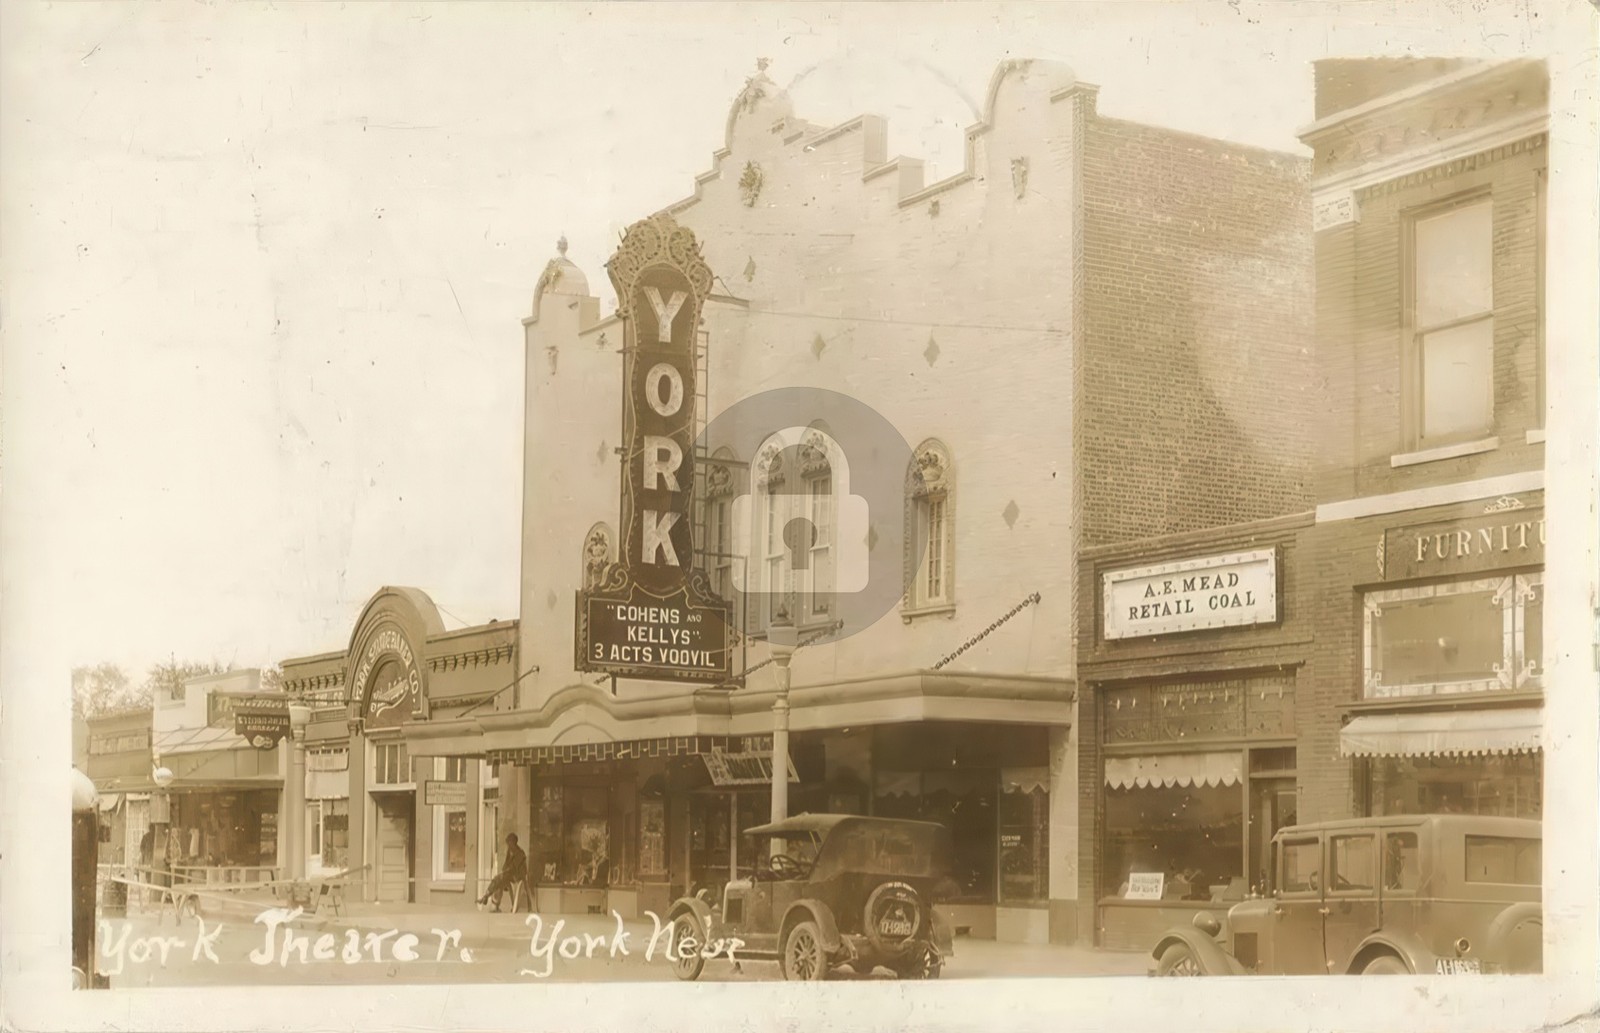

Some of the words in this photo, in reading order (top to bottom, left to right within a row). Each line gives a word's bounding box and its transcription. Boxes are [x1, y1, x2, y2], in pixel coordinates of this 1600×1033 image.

[641, 286, 689, 567] YORK
[1144, 581, 1177, 598] A.E.
[1183, 572, 1239, 593] MEAD
[606, 604, 680, 624] "COHENS
[1128, 599, 1194, 620] RETAIL
[1208, 590, 1256, 610] COAL
[627, 625, 701, 645] KELLYS"
[594, 643, 604, 659] 3
[610, 645, 652, 662] ACTS
